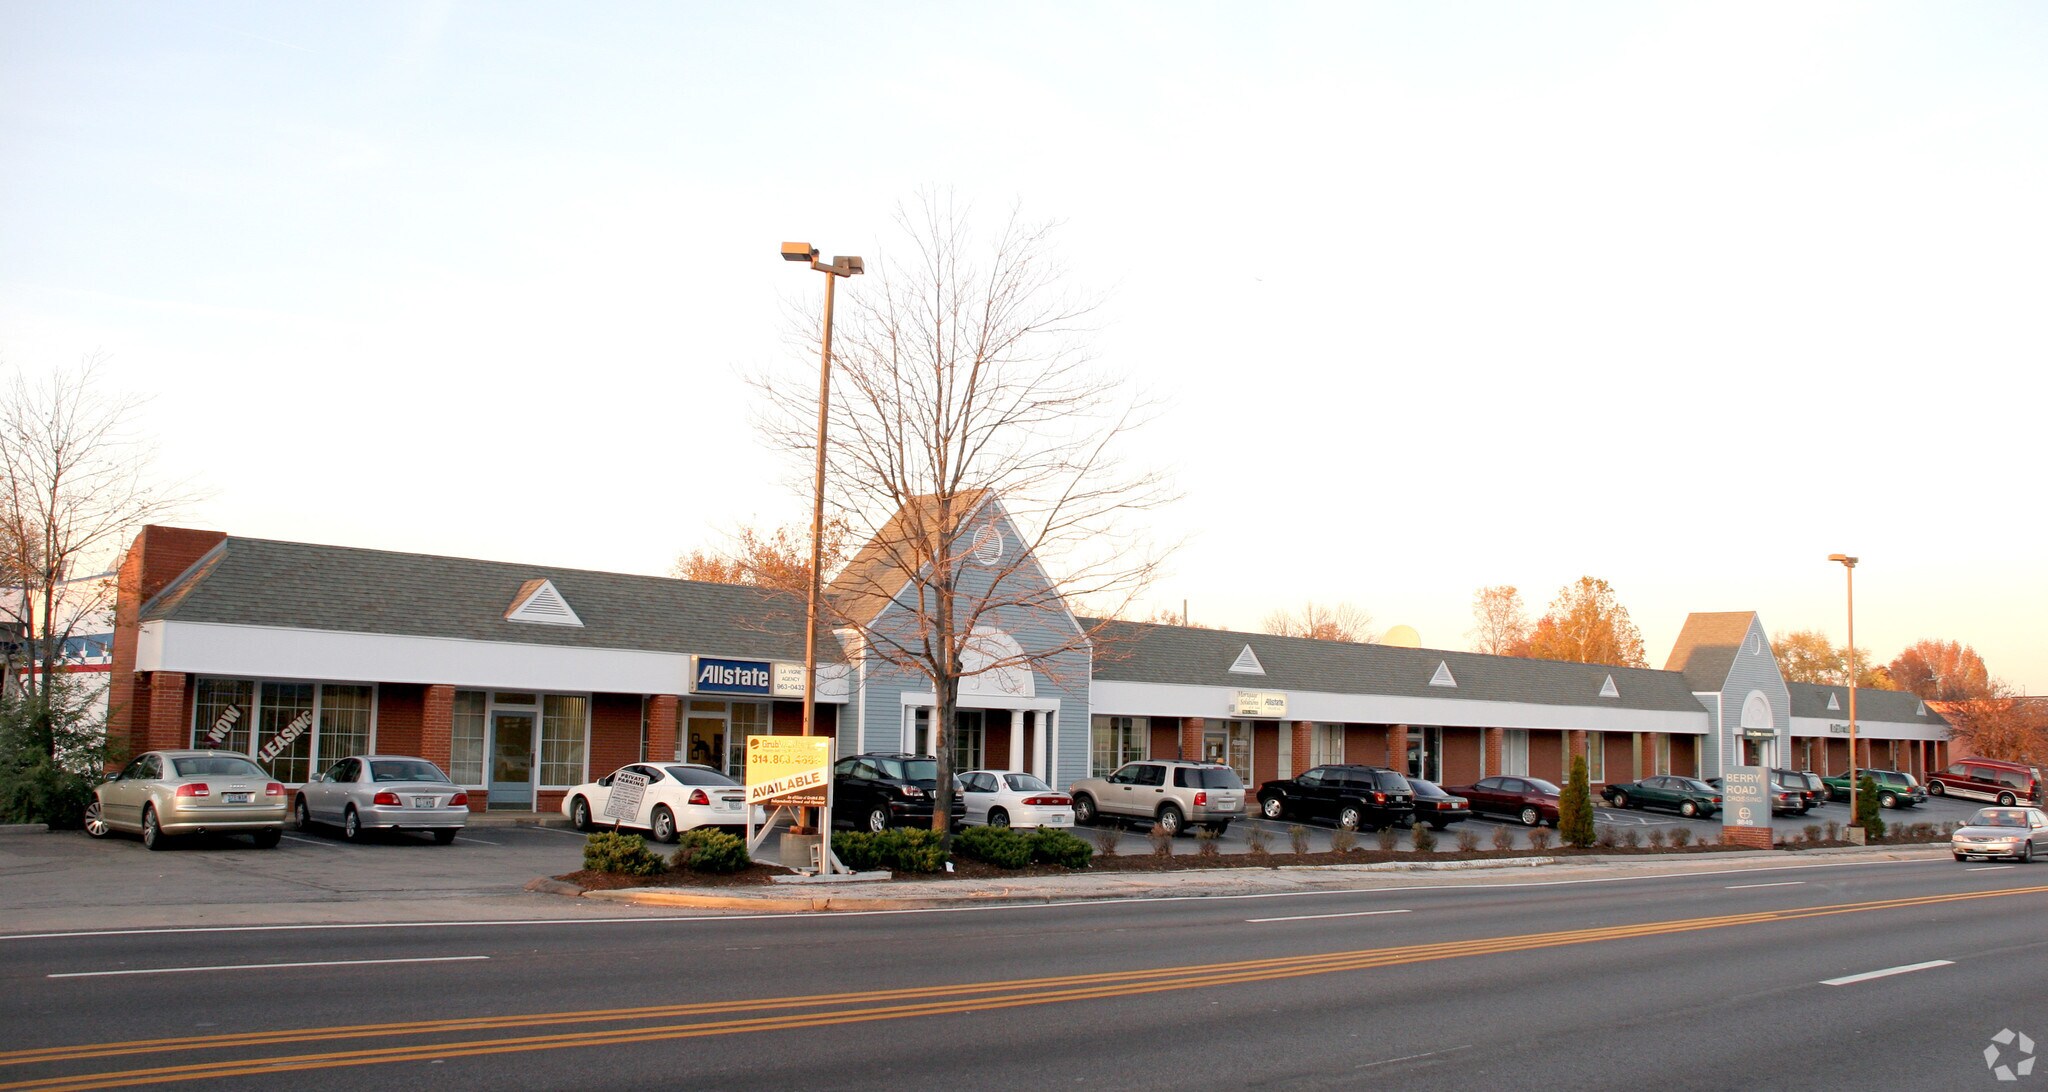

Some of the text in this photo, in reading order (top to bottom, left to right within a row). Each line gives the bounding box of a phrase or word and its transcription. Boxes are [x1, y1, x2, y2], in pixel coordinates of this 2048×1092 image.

[698, 665, 769, 687] Allstate
[777, 683, 805, 691] 963-0432
[1265, 698, 1284, 706] Allstate
[208, 704, 313, 763] NOW LEASING
[617, 777, 645, 787] PARKING
[620, 773, 645, 782] PRIVATE
[1726, 773, 1760, 783] BERRY
[752, 772, 821, 799] AVAILABLE
[1726, 785, 1757, 795] ROAD
[1726, 795, 1762, 803] CROSSING
